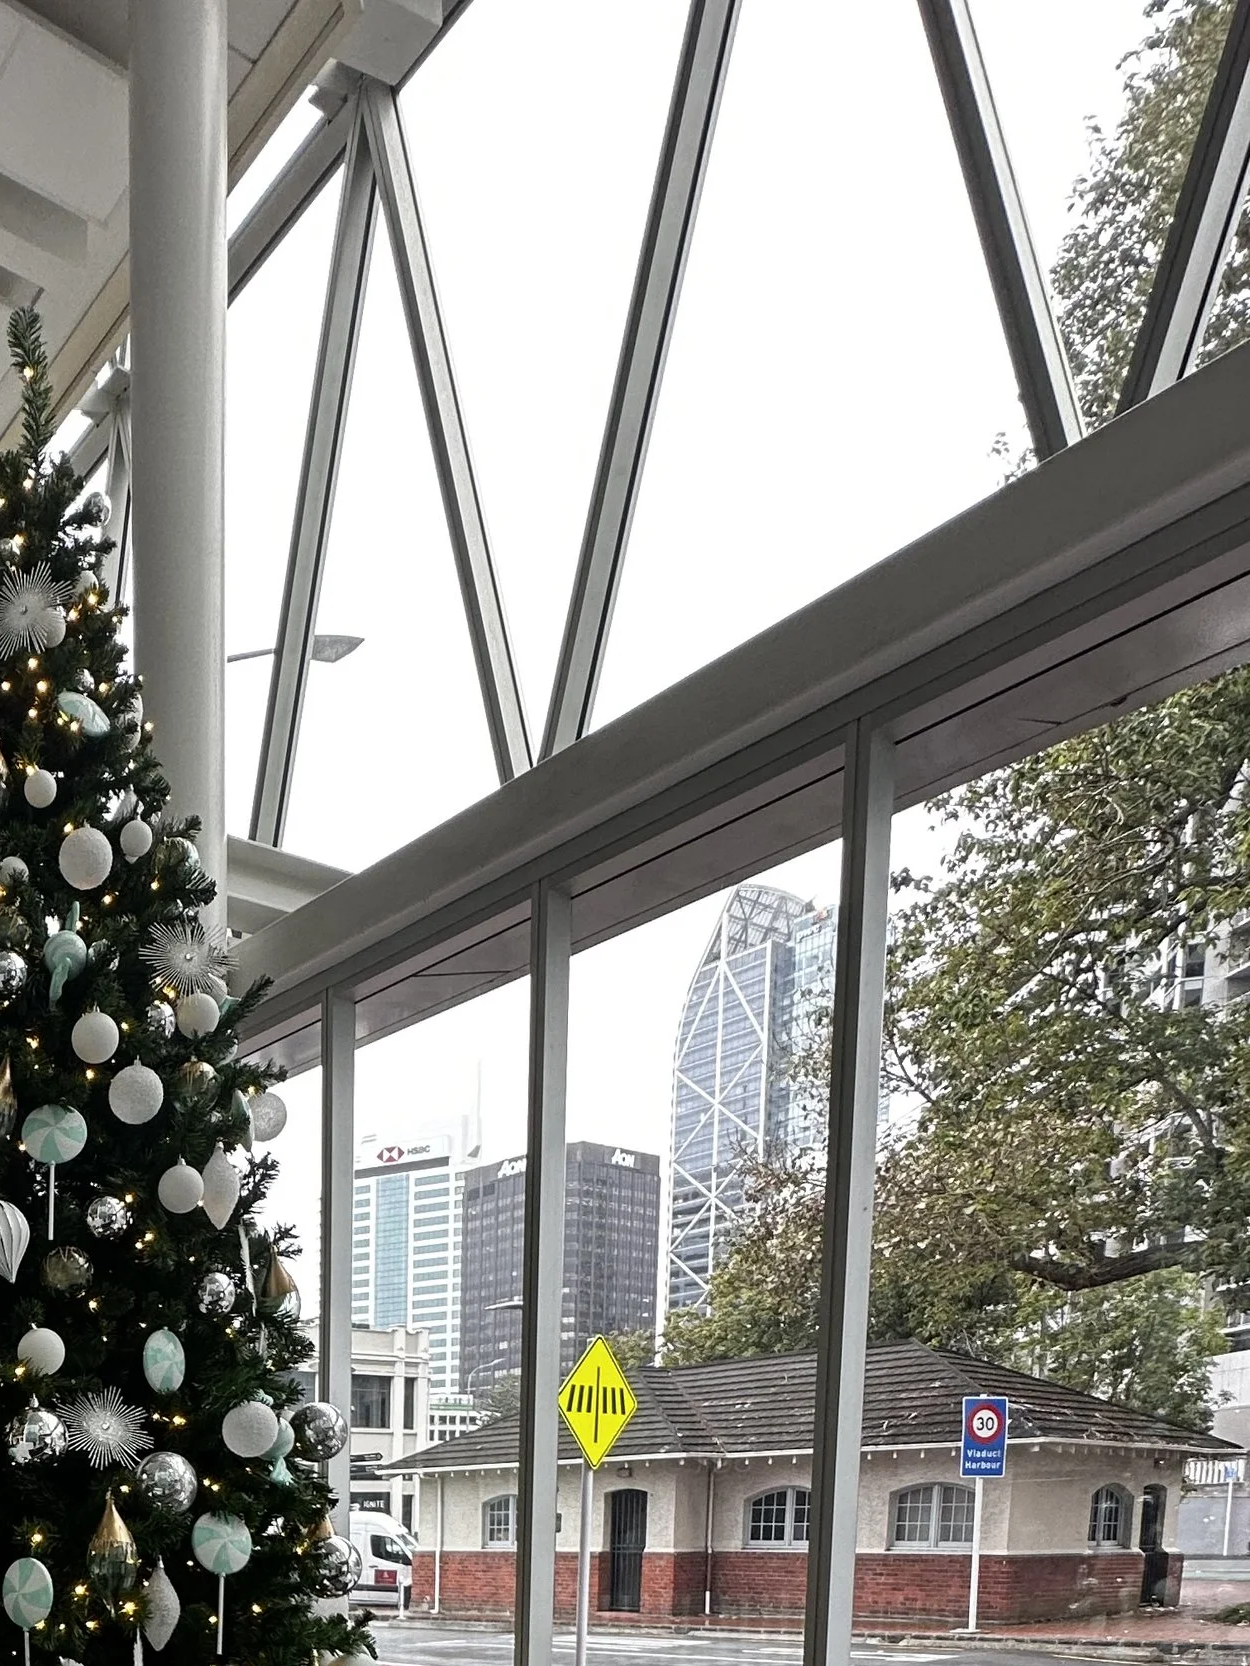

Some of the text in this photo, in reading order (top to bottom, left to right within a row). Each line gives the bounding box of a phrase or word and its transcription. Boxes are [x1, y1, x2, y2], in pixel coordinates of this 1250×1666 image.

[407, 1145, 431, 1155] HSBC
[976, 1416, 995, 1431] 30
[966, 1449, 1002, 1458] Viaduct
[965, 1461, 1002, 1469] Harbour
